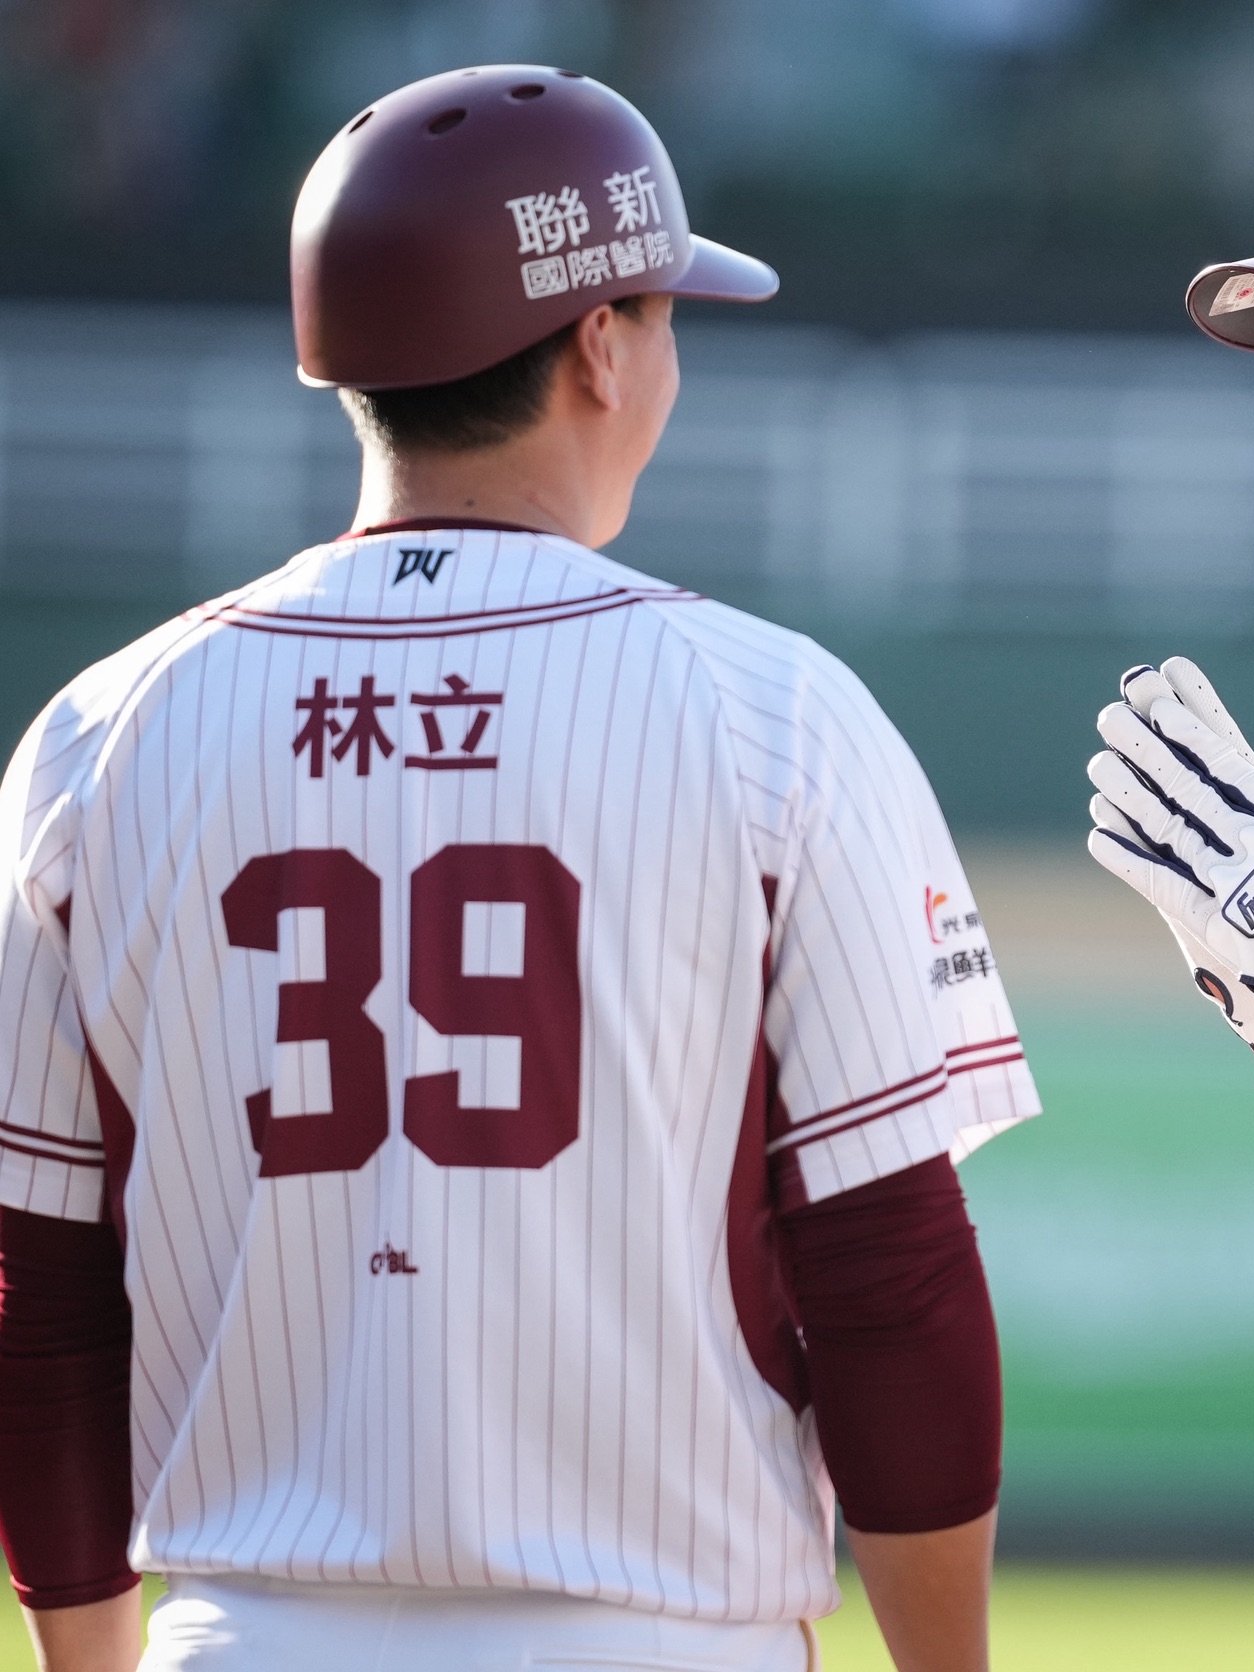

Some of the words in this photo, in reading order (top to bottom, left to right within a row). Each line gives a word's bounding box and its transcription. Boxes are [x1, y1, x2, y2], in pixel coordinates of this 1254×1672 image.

[505, 165, 662, 255] 聯新
[520, 229, 675, 299] 國際醫院
[292, 673, 504, 778] 林立
[221, 843, 582, 1178] 39
